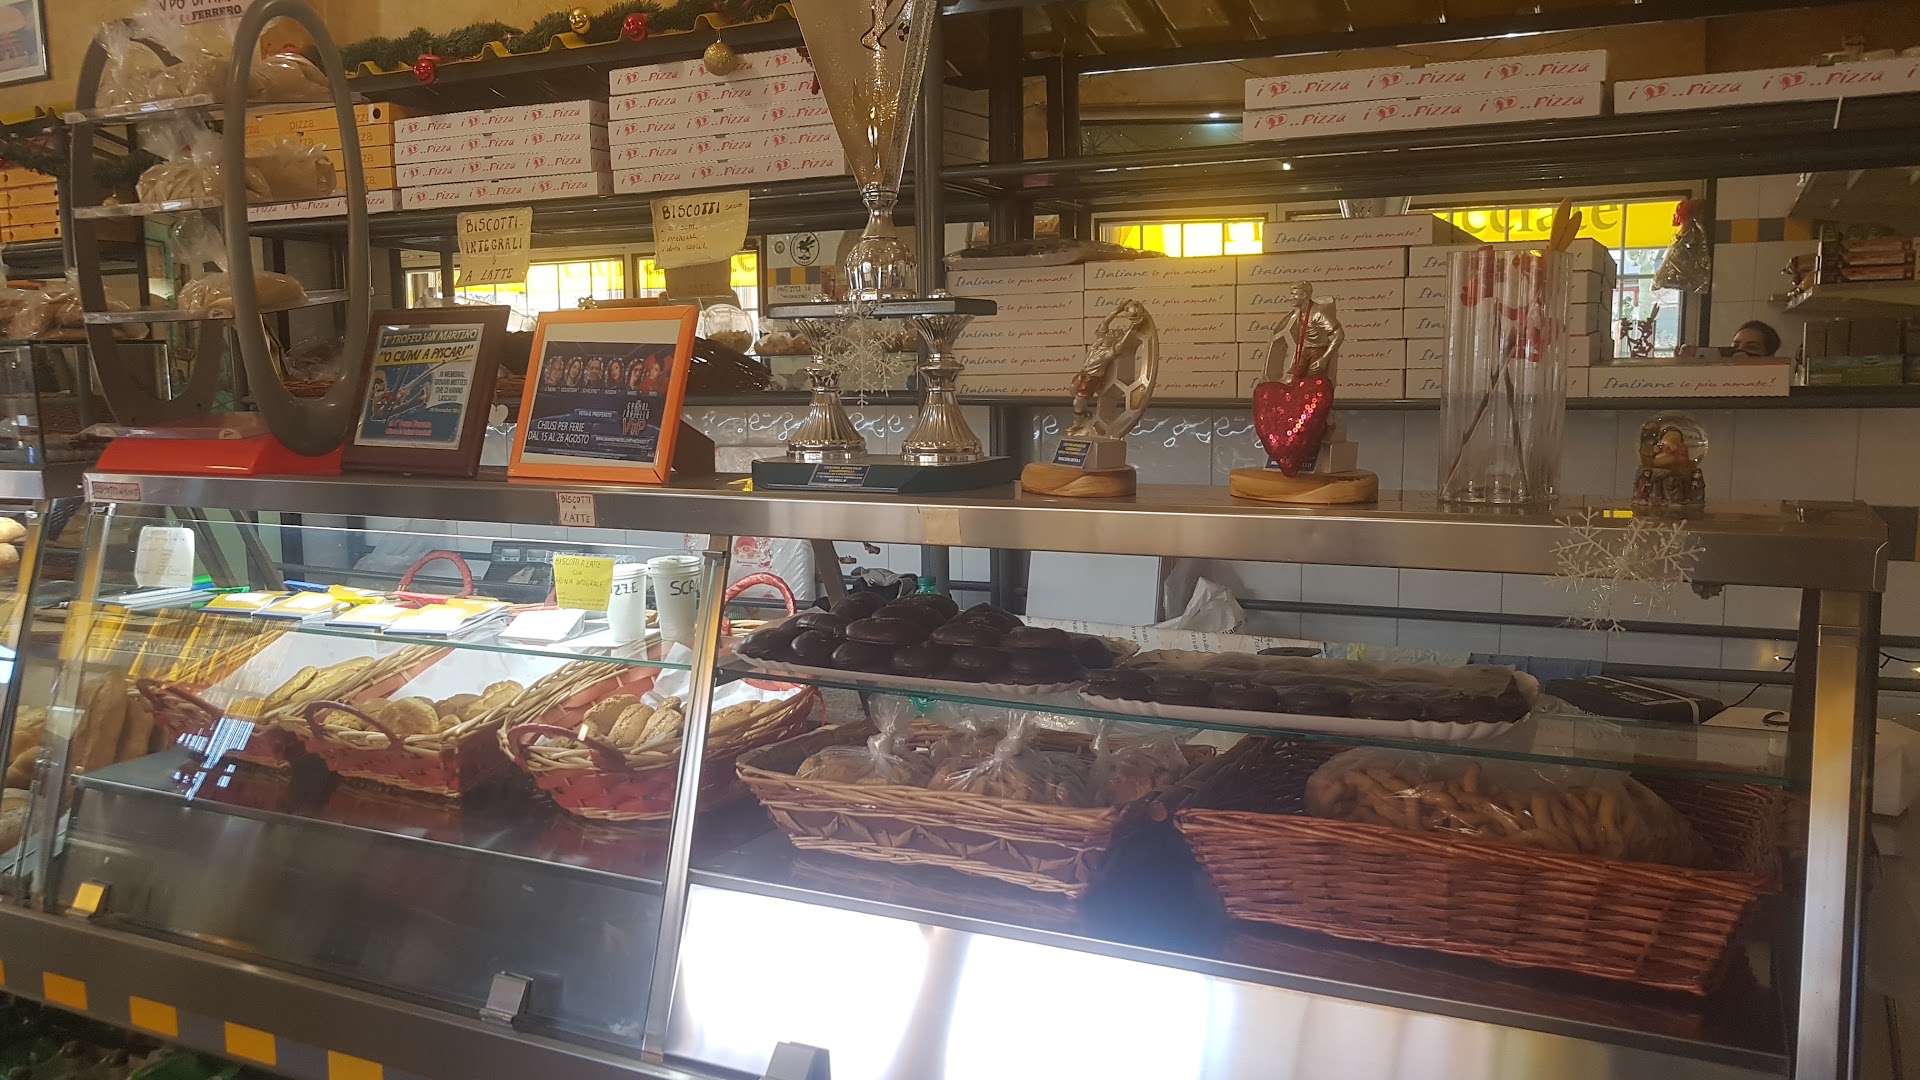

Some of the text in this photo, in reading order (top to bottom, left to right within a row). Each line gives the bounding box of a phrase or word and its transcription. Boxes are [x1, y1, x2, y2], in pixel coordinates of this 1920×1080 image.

[192, 5, 242, 20] FERRERO
[290, 118, 314, 130] pizza
[661, 202, 720, 219] BISCOTTI
[465, 238, 523, 254] INTEGRALI
[465, 268, 513, 282] A LATTE
[392, 334, 422, 344] TROFEO
[423, 333, 436, 341] SAN
[439, 329, 477, 340] MARTINO
[422, 350, 429, 359] A
[537, 420, 585, 432] CHIUSI PER FERIE
[528, 431, 539, 440] DAL
[541, 433, 548, 441] 15
[548, 434, 556, 442] AL
[565, 434, 589, 444] AGOSTO
[560, 495, 591, 504] BISCOTTI
[564, 512, 590, 524] LATTE
